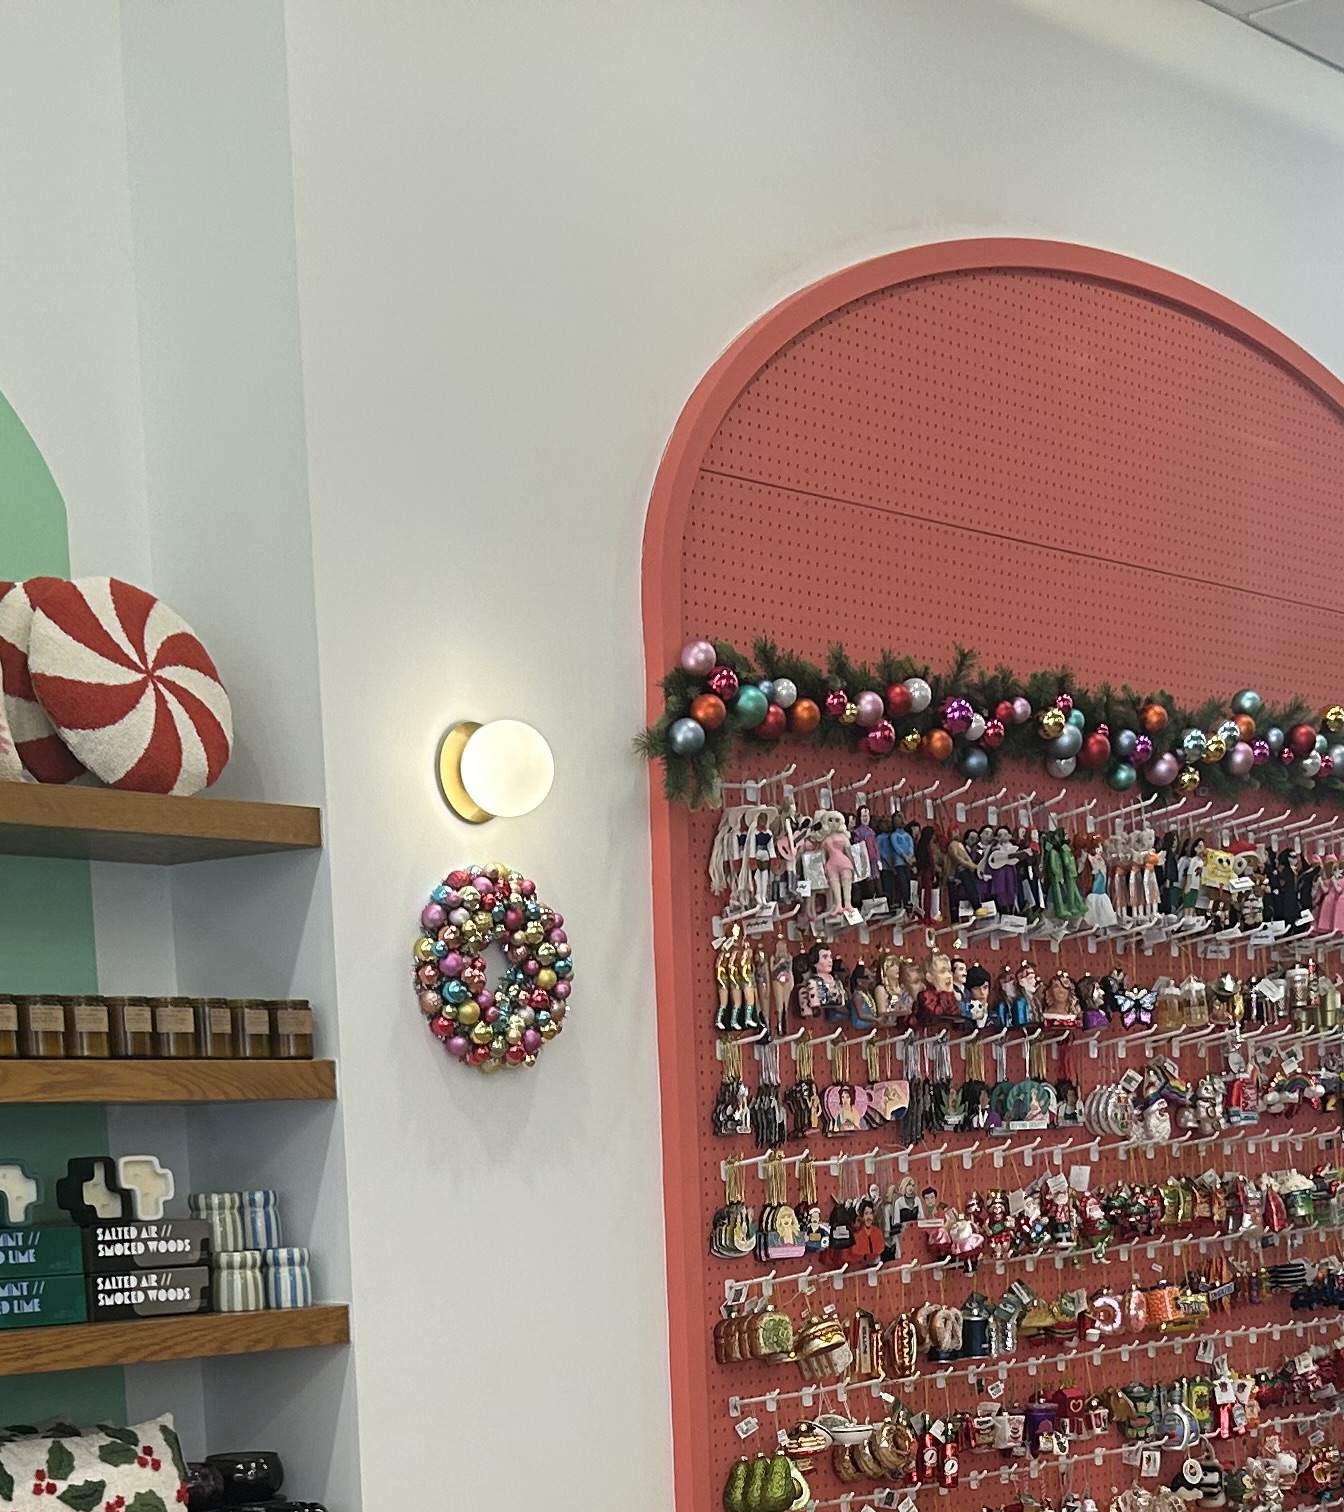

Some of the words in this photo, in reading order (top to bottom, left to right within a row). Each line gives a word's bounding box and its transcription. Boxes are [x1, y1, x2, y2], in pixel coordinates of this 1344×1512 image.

[97, 1226, 137, 1241] SALTED
[140, 1225, 158, 1239] AIR
[98, 1241, 145, 1257] SMOKED
[147, 1239, 191, 1253] WOODS
[9, 1249, 36, 1264] LIME
[97, 1275, 137, 1291] SALTED
[140, 1274, 158, 1288] AIR
[14, 1298, 41, 1313] LIME
[98, 1290, 145, 1307] SMOKED
[147, 1288, 191, 1302] WOODS
